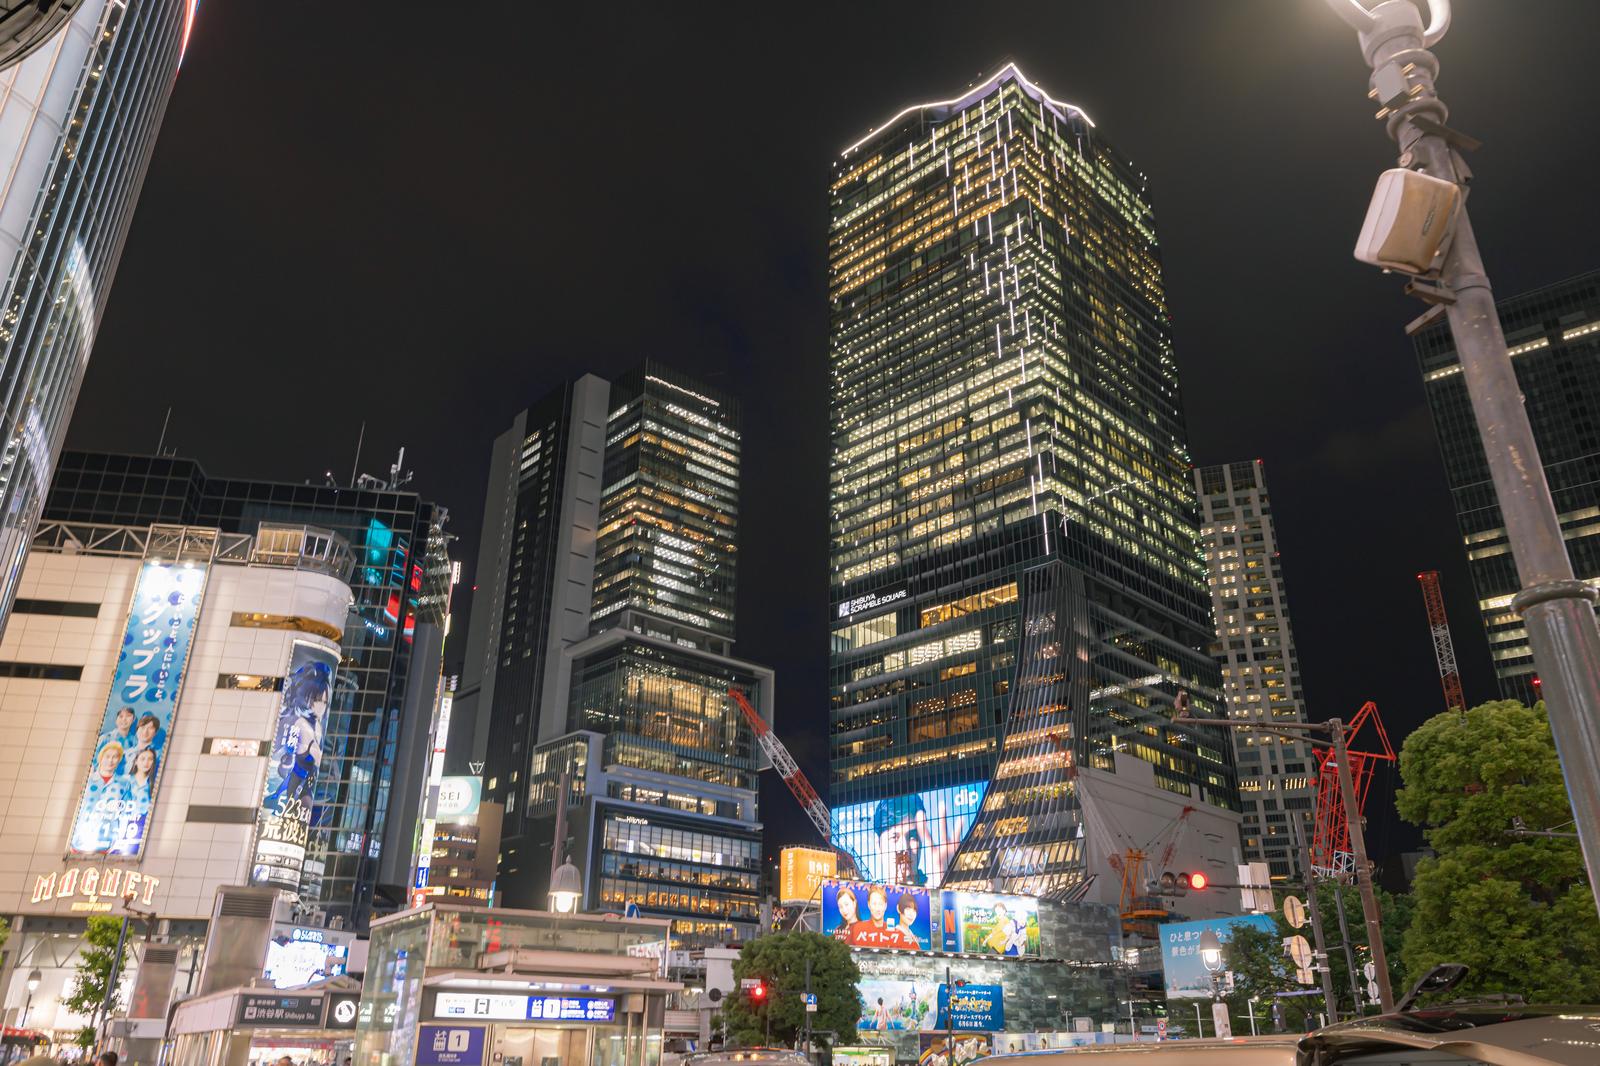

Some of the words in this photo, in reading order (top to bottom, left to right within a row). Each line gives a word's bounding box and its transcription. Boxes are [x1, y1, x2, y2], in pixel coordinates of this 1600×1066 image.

[851, 593, 876, 607] SHIBUYA
[851, 598, 881, 614] SCRAMBLE
[882, 590, 907, 604] SQUARE
[31, 866, 160, 905] MAGNET
[257, 1007, 284, 1019] 渋谷駅
[456, 1034, 461, 1047] 1
